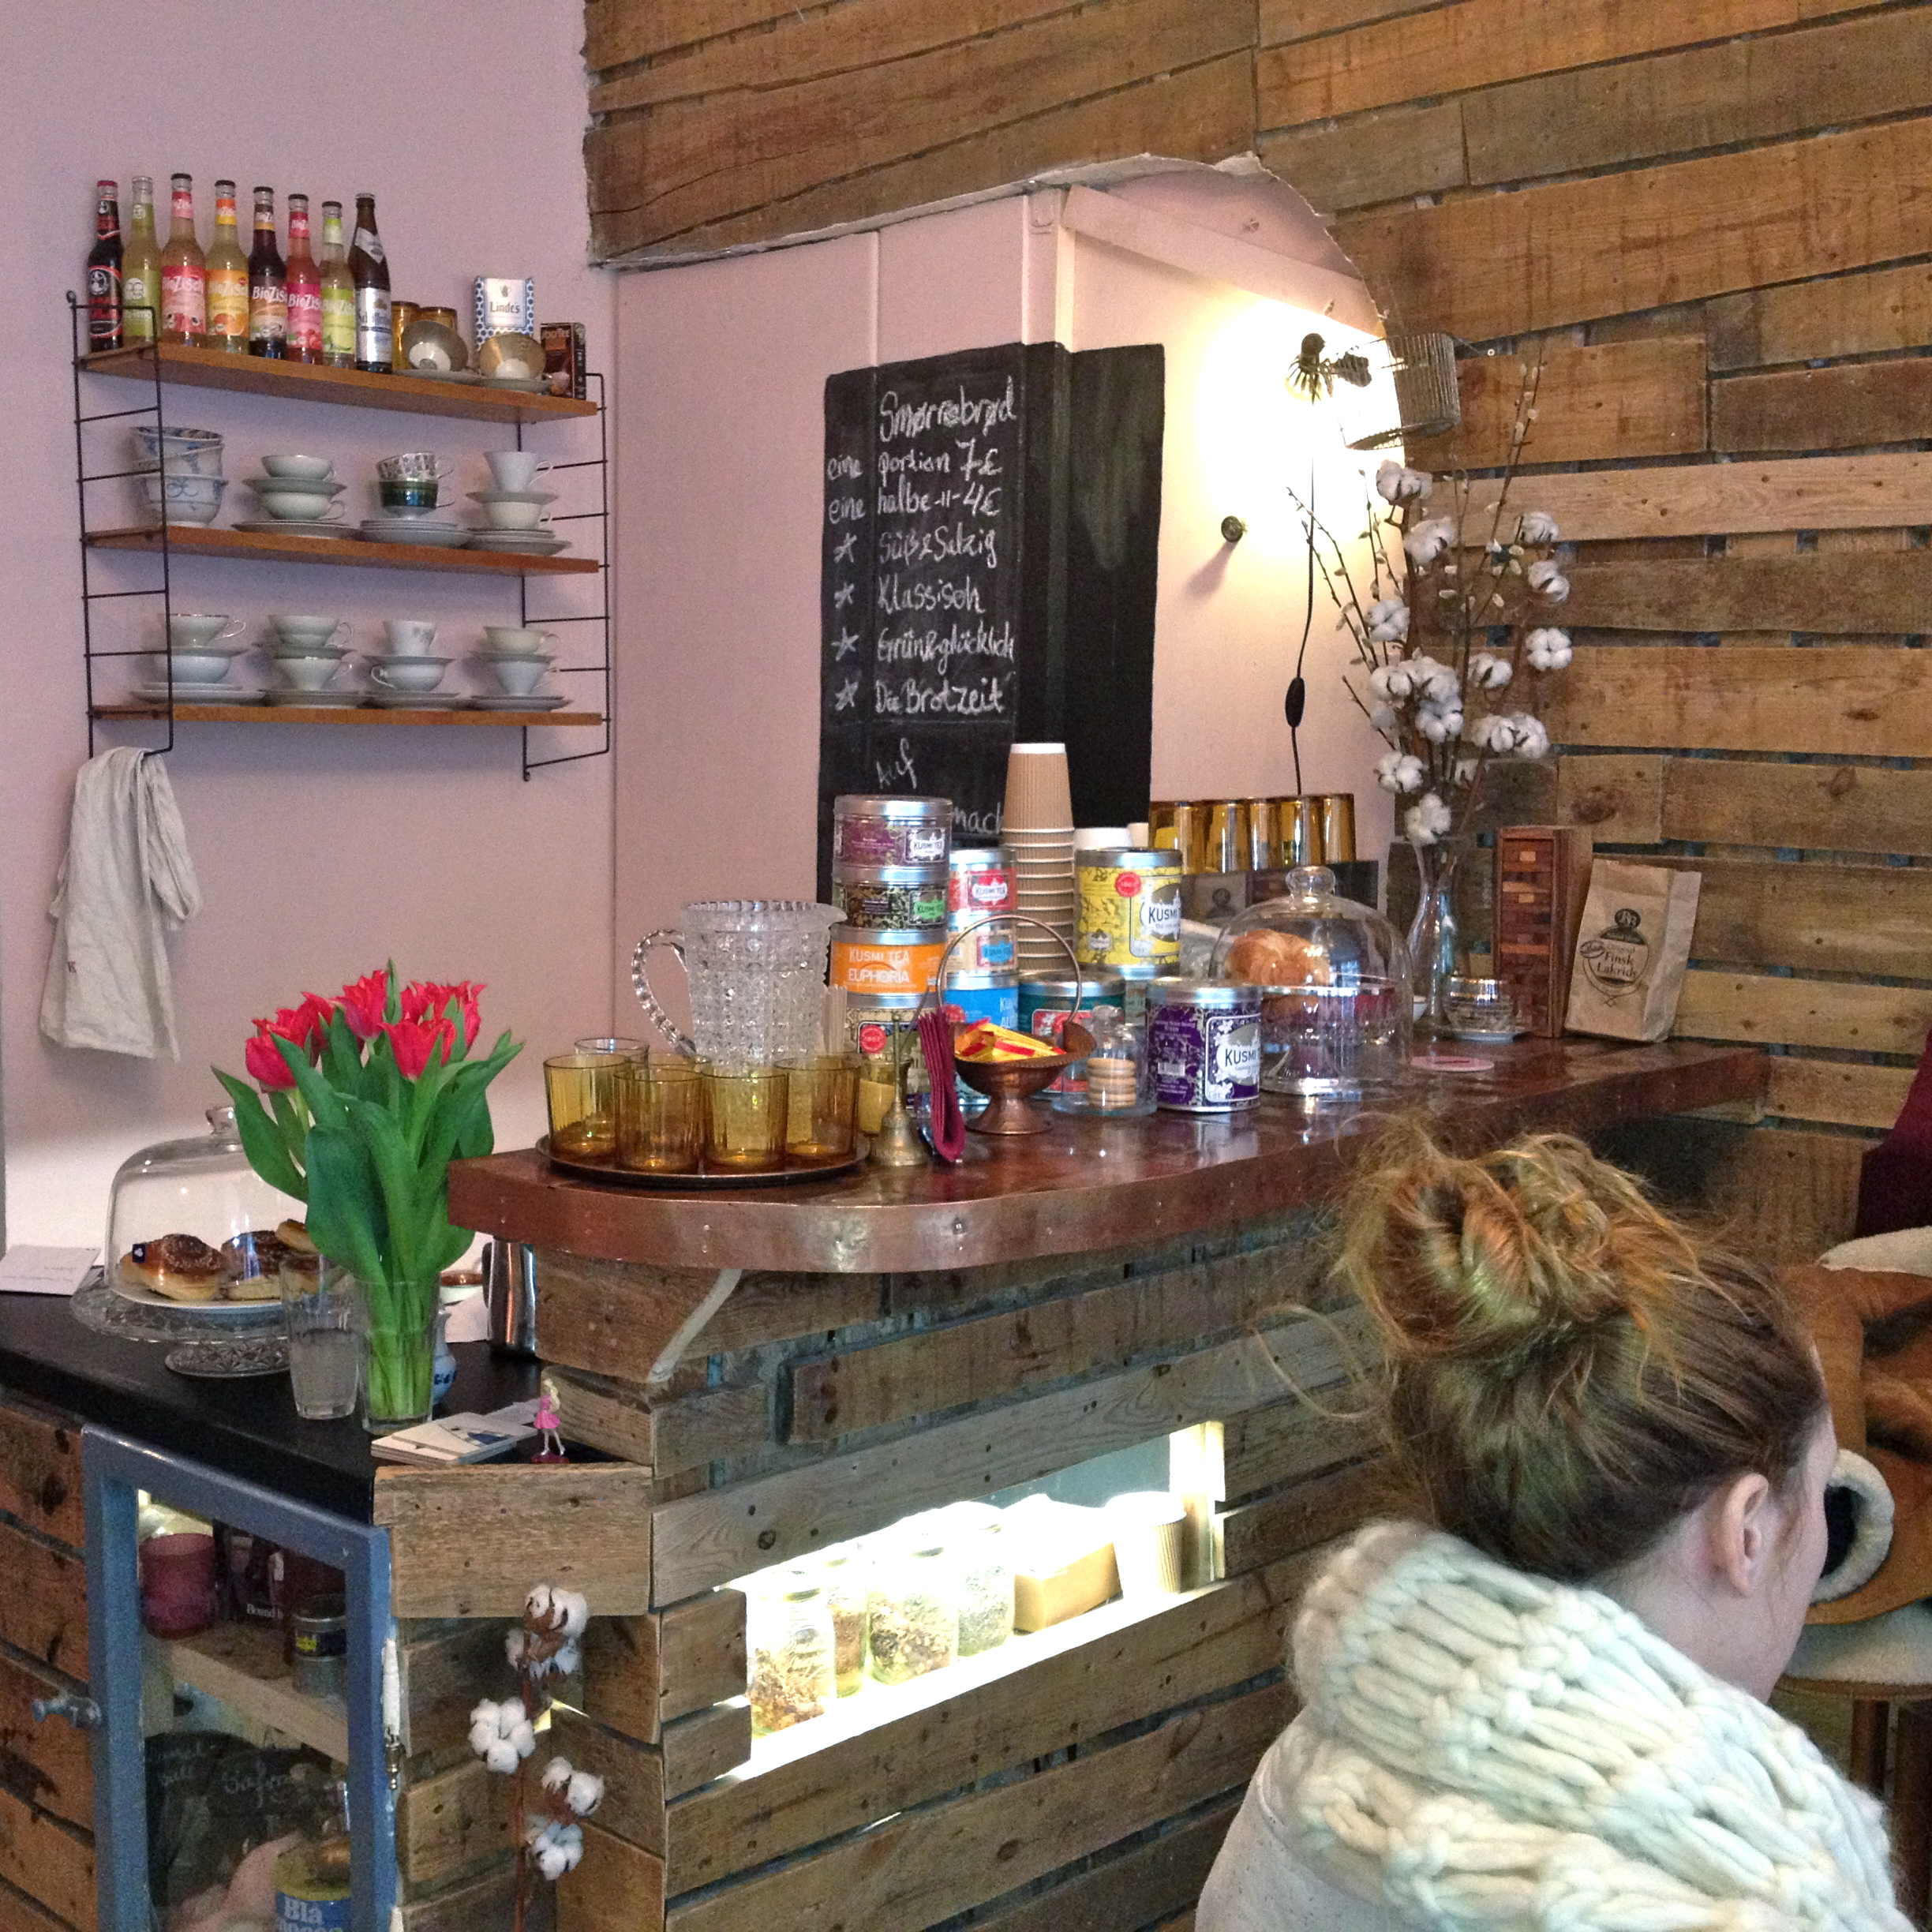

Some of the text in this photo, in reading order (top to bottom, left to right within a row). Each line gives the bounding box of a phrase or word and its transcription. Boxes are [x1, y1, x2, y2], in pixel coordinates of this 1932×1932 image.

[829, 497, 866, 525] eine
[877, 474, 932, 515] halbe
[1148, 906, 1178, 924] KUSMI
[849, 948, 885, 963] KUSMI
[889, 949, 910, 965] TEA
[848, 968, 911, 983] EUPHORIA
[1225, 1048, 1256, 1067] KUSMI
